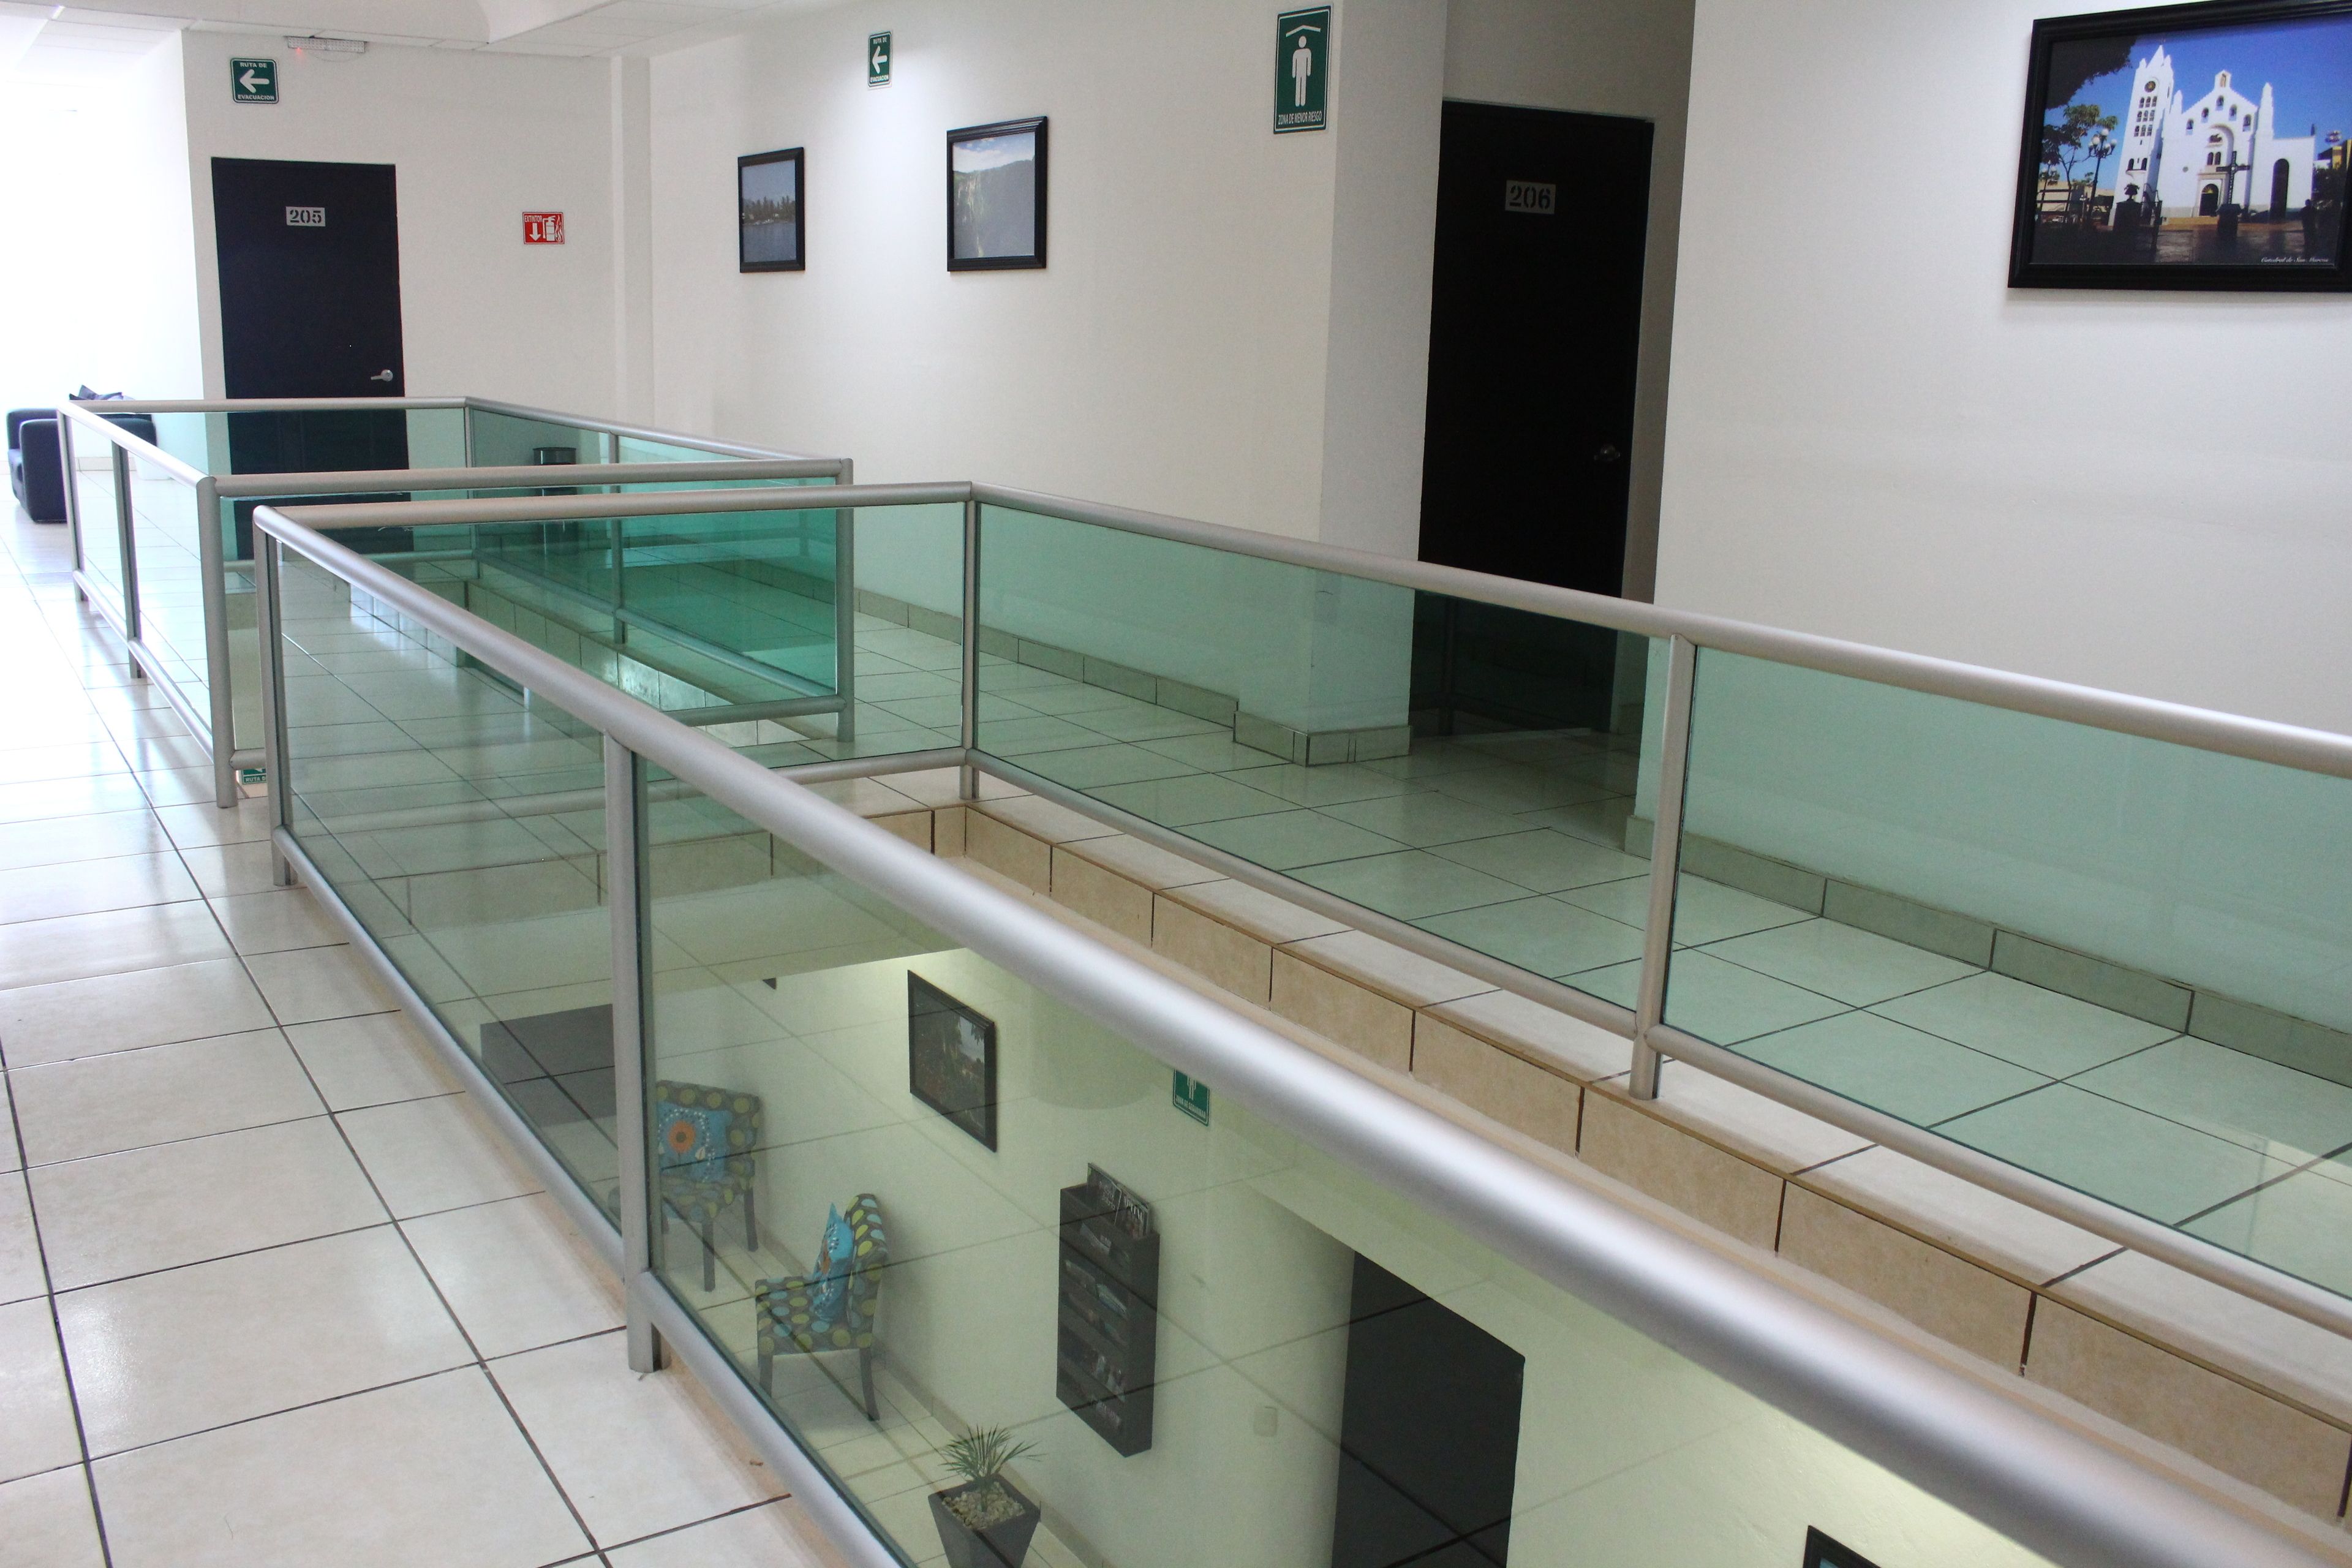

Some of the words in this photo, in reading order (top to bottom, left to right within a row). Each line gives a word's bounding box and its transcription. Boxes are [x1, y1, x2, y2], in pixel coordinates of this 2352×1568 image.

[1278, 114, 1288, 125] ZONA
[1289, 113, 1294, 124] DE
[1294, 111, 1308, 123] MENOR
[1308, 110, 1322, 122] RIESGO
[1509, 185, 1550, 209] 206
[290, 209, 322, 224] 205
